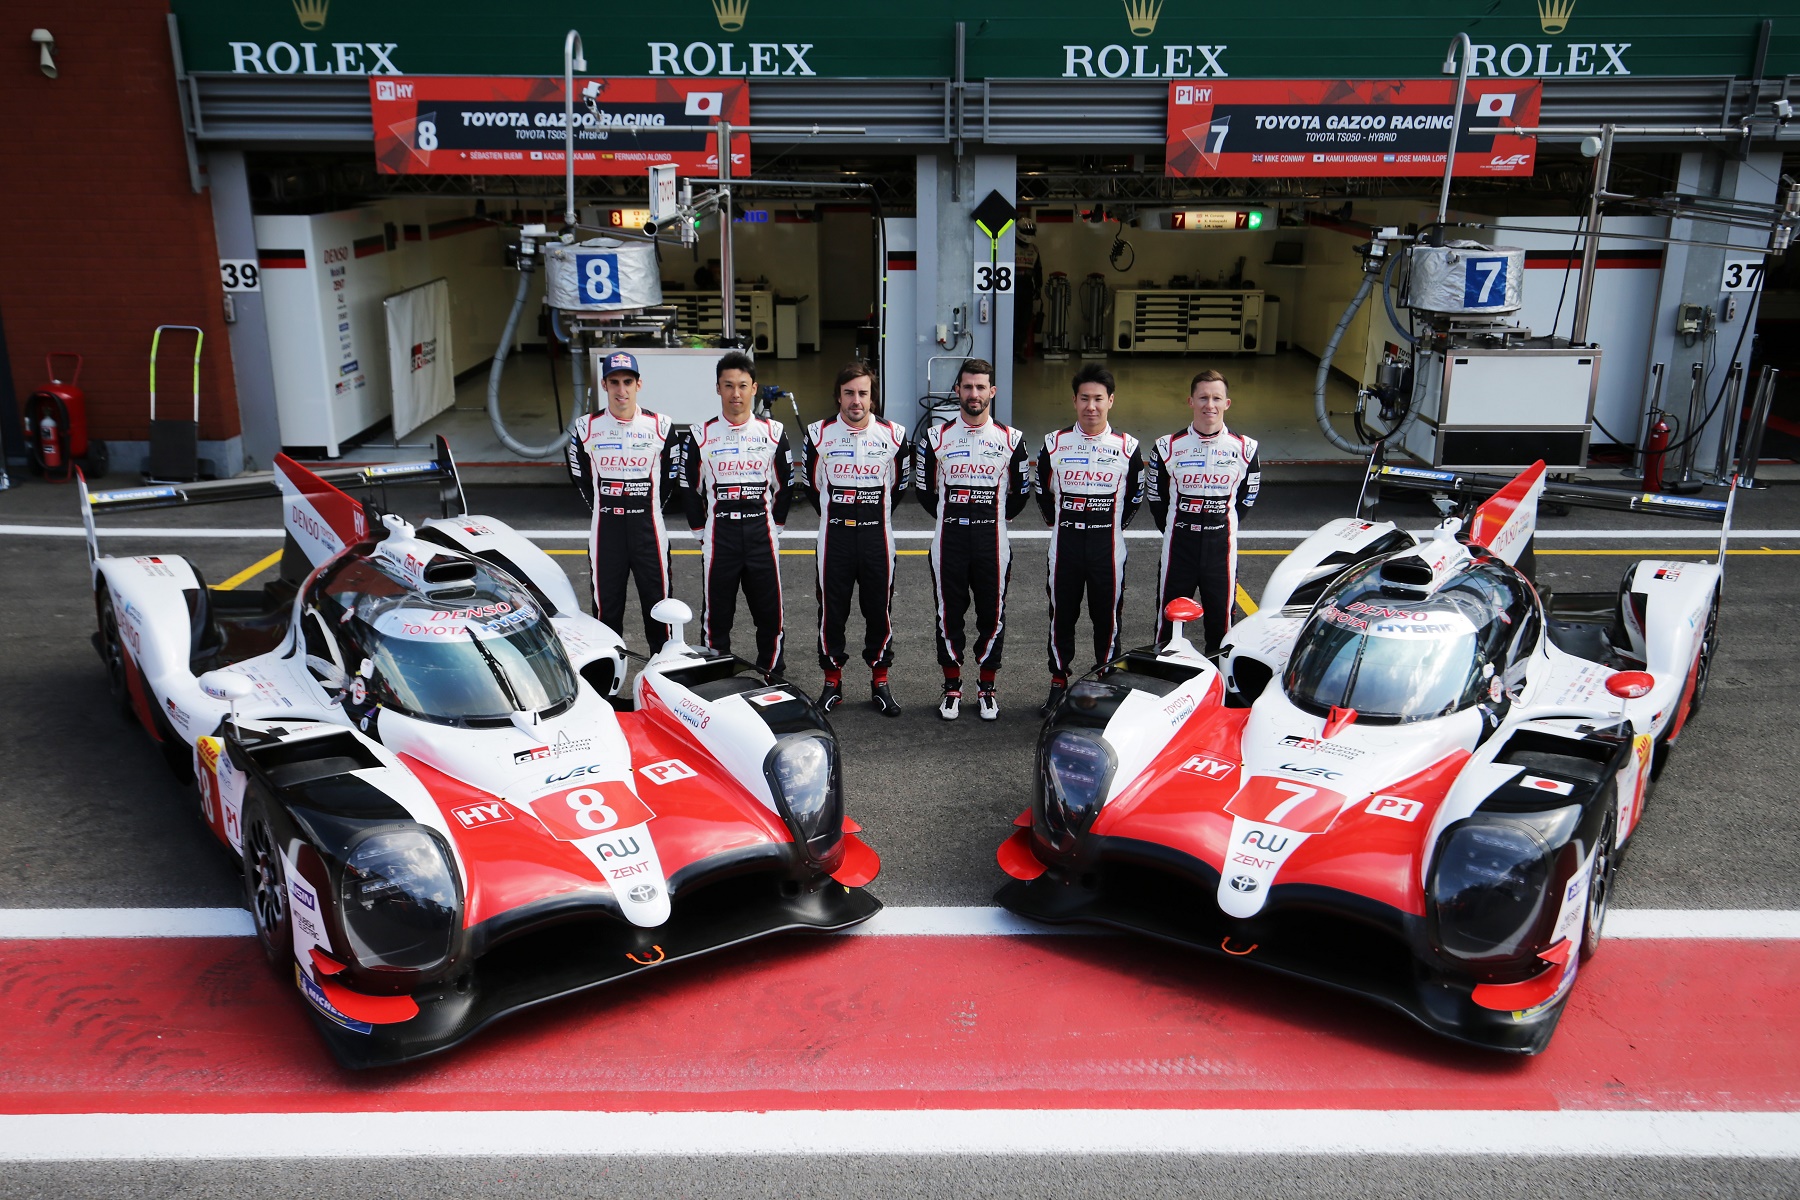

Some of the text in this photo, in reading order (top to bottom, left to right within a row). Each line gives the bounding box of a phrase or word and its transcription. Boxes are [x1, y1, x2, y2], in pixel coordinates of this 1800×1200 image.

[228, 42, 403, 75] ROLEX
[648, 42, 816, 76] ROLEX
[1062, 45, 1228, 78] ROLEX
[1467, 43, 1631, 76] ROLEX
[379, 85, 413, 98] P1 HY
[1178, 88, 1211, 102] P1 HY
[461, 112, 665, 127] TOYOTA GAZOO RACING
[1255, 115, 1454, 130] TOYOTA GAZOO RACING
[418, 121, 438, 151] 8
[516, 129, 608, 140] TOYOTA TS05 HYBRID
[1211, 125, 1229, 154] 7
[1306, 132, 1397, 142] TOYOTA TS050 HYBRID
[504, 152, 523, 160] BUEMI
[543, 152, 565, 161] KAZUKI
[615, 152, 671, 161] FERNANDO ALONSO
[1265, 154, 1305, 162] MIKE CONWAY
[1325, 154, 1377, 162] KAMUI KOBAYASHI
[1491, 154, 1530, 165] WEC
[612, 212, 622, 229] 8
[1175, 213, 1183, 227] 7
[1238, 213, 1247, 227] 7
[222, 263, 259, 289] 39
[584, 258, 614, 299] 8
[976, 266, 1012, 292] 38
[1475, 261, 1503, 303] 7
[1725, 263, 1763, 289] 37
[626, 431, 647, 439] Mobil
[1091, 445, 1112, 455] Mobil
[1211, 448, 1231, 457] Mobil
[386, 464, 431, 473] MICHELIN
[600, 456, 648, 467] DENSO
[718, 460, 763, 471] DENSO
[833, 463, 881, 475] DENSO
[950, 463, 996, 475] DENSO
[1063, 470, 1114, 483] DENSO
[1182, 473, 1230, 485] DENSO
[1402, 469, 1448, 480] MICHELIN
[112, 489, 167, 500] MICHELIN
[831, 494, 856, 504] GR
[1179, 502, 1202, 513] GR
[1665, 497, 1720, 509] MICHELIN
[293, 505, 319, 540] DENSO
[403, 553, 425, 579] ZENT
[430, 601, 512, 622] DENSO
[480, 604, 536, 632] HYBRID
[1323, 603, 1368, 631] TOYOTA
[1345, 601, 1428, 622] DENSO
[401, 623, 468, 636] TOYOTA
[1376, 623, 1458, 635] HYBRID
[679, 697, 711, 730] TOYOTA 8
[1163, 695, 1189, 717] TOYOTA
[673, 706, 699, 729] HYBRID
[1170, 704, 1194, 727] HYBRID
[200, 738, 219, 761] DHL
[1279, 737, 1316, 751] GR
[1319, 745, 1359, 757] GAZOO
[1324, 741, 1366, 755] TOYOTA
[515, 749, 551, 765] GR
[1316, 748, 1355, 760] Racing
[545, 764, 601, 784] WEC
[656, 763, 688, 781] P1
[1187, 756, 1228, 777] HY
[1279, 763, 1344, 780] WEC
[565, 788, 618, 831] 8
[1264, 781, 1318, 823] 7
[1378, 799, 1411, 817] P1
[225, 804, 240, 840] P1
[457, 802, 502, 827] HY
[1232, 852, 1275, 871] ZENT
[610, 861, 650, 880] ZENT
